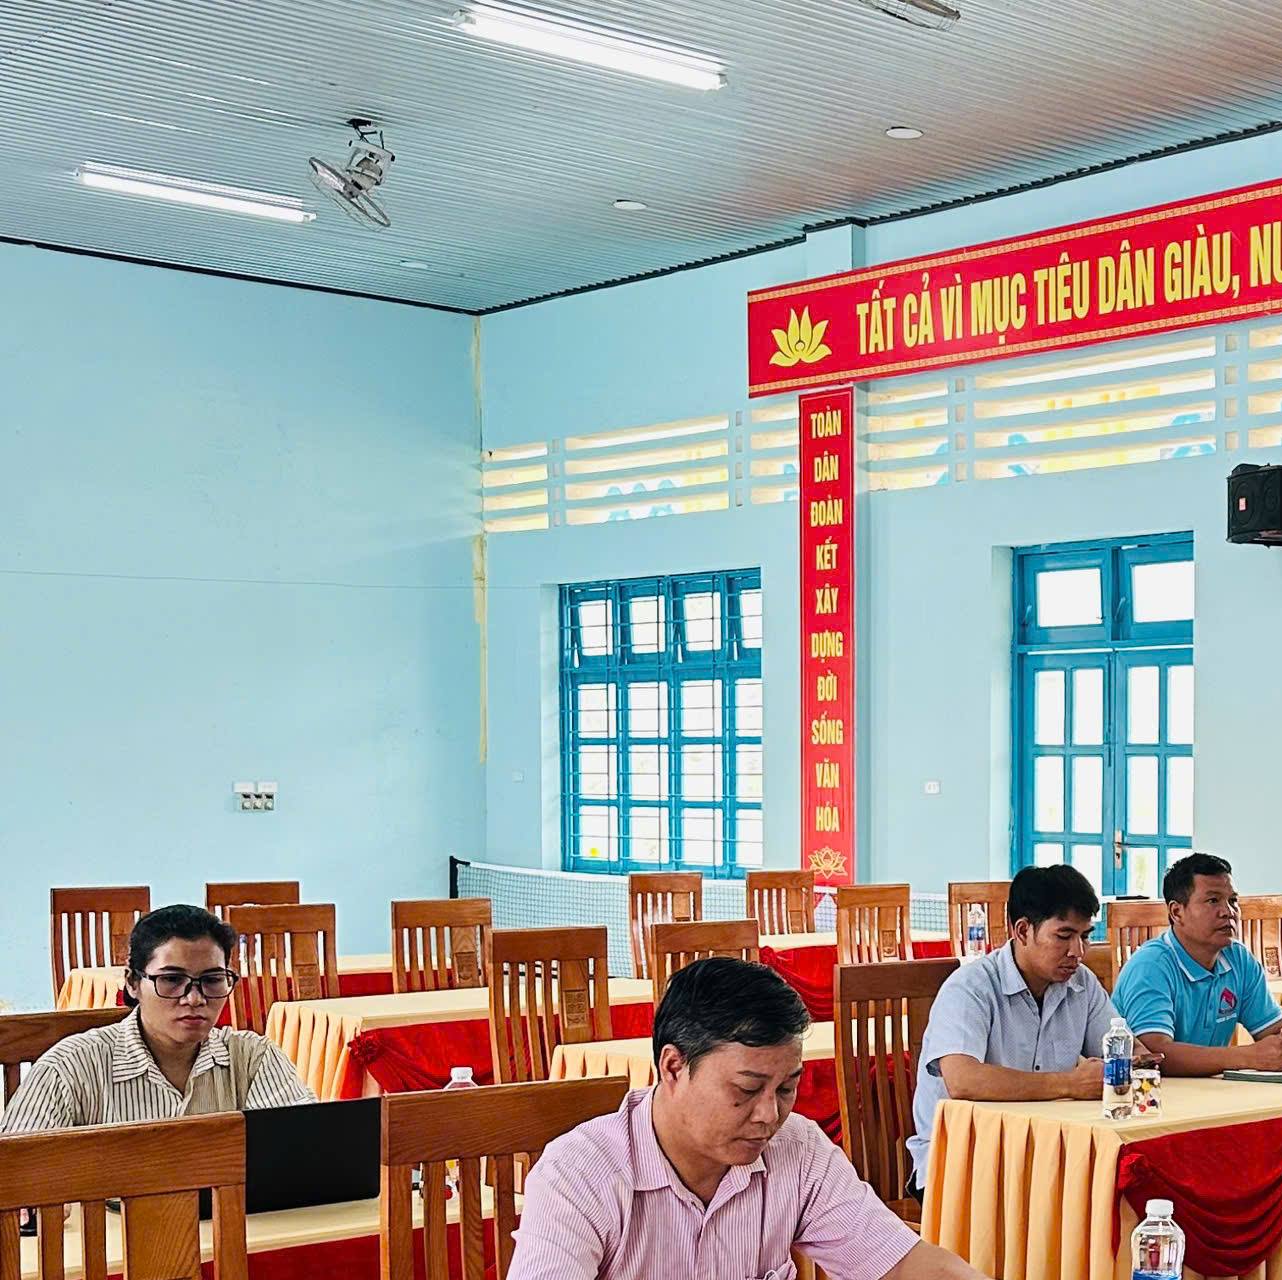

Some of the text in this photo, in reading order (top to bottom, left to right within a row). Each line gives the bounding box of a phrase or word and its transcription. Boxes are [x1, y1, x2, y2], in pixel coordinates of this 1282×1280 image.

[857, 281, 897, 354] TẤT
[903, 273, 935, 347] CẢ
[940, 272, 963, 341] VÌ
[971, 273, 1027, 344] MỤC
[1034, 253, 1090, 325] TIÊU
[1099, 239, 1155, 314] DÂN
[1165, 224, 1240, 302] GIÀU,
[811, 406, 842, 438] TOÀN
[814, 450, 839, 482] DÂN
[811, 494, 843, 526] ĐOÀN
[816, 534, 838, 571] KẾT
[815, 583, 839, 614] XÂY
[811, 629, 843, 664] DỰNG
[816, 669, 838, 702] ĐỜI
[811, 709, 843, 746] SỐNG
[815, 757, 840, 789] VĂN
[815, 797, 840, 833] HÓA
